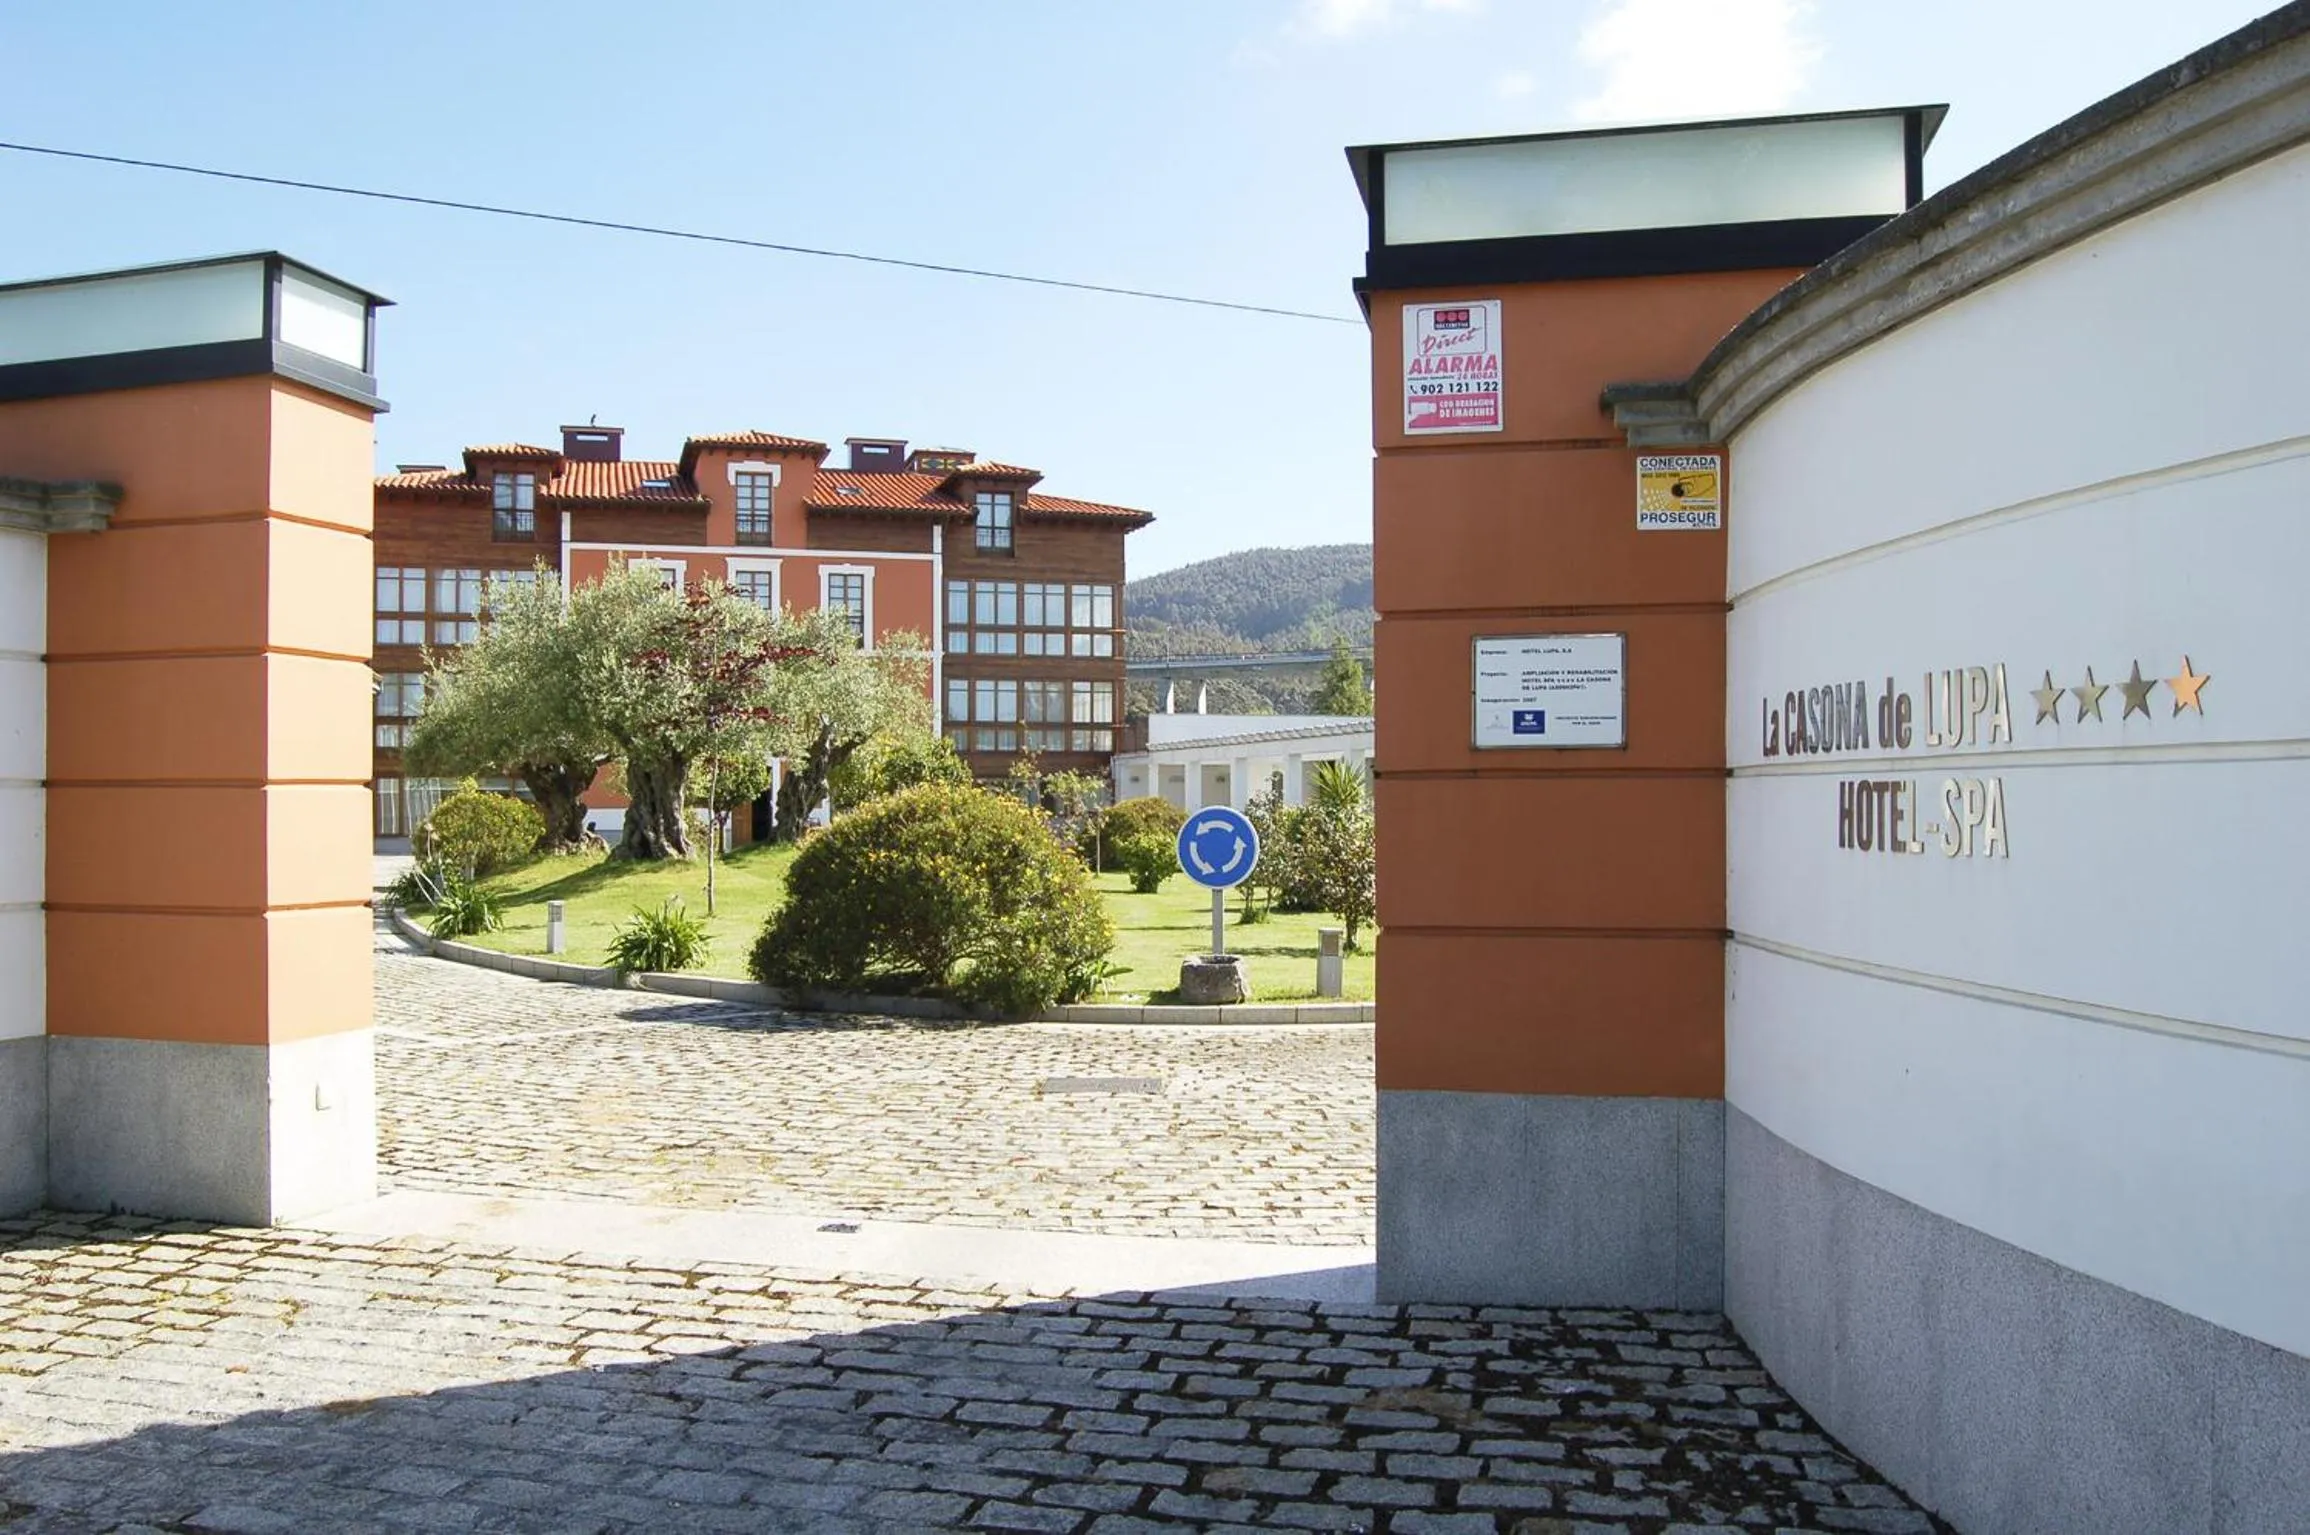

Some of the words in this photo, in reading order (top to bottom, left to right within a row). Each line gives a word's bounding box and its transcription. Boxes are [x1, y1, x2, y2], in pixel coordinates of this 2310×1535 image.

[1423, 326, 1484, 354] Direct
[1408, 354, 1498, 375] ALARMA
[1420, 384, 1444, 395] 902
[1449, 382, 1470, 393] 121
[1476, 381, 1499, 392] 122
[1640, 456, 1717, 468] CONECTADA
[1640, 512, 1717, 524] PROSEGUR
[1763, 698, 1780, 757] La
[1785, 680, 1870, 756] CASONA
[1878, 677, 1913, 749] de
[1924, 662, 2012, 749] LUPA
